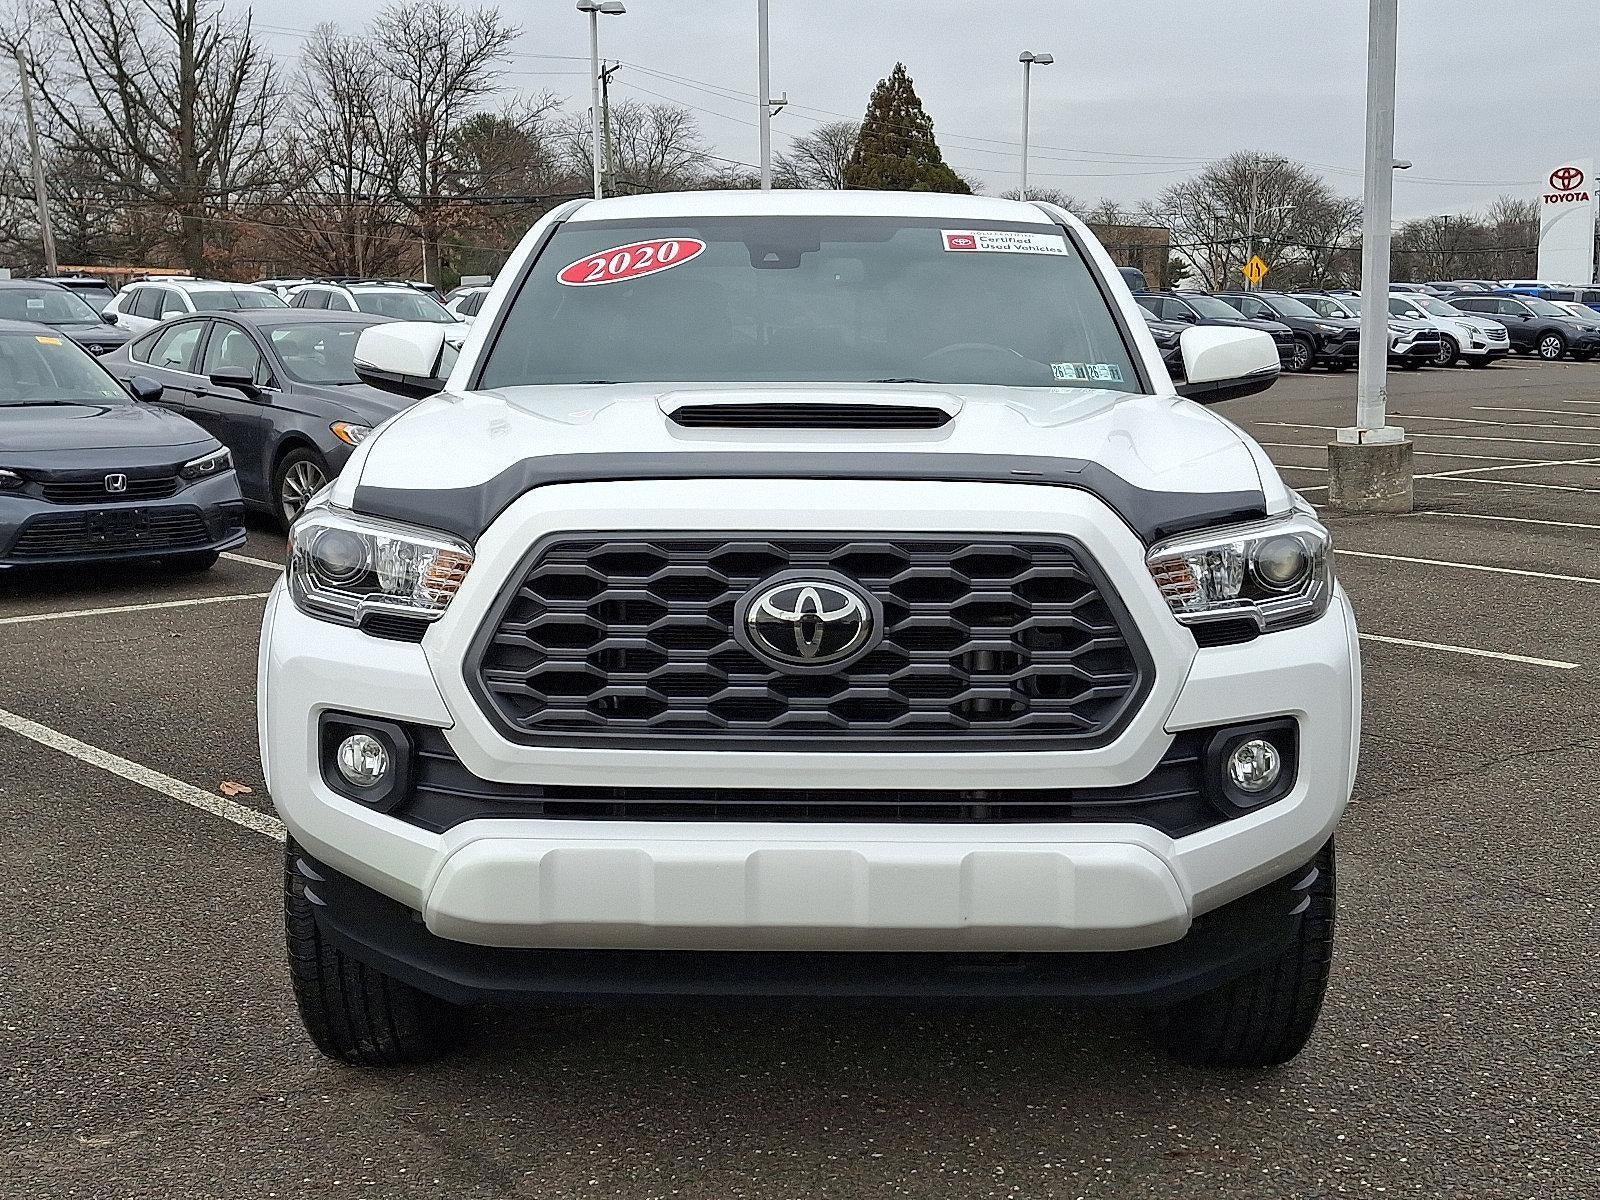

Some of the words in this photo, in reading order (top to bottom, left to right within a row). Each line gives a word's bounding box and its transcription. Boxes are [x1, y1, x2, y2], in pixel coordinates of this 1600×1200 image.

[1543, 192, 1589, 204] TOYOTA
[979, 236, 1031, 244] Certified
[1013, 244, 1063, 253] Vehicles
[583, 241, 680, 282] 2020
[1053, 365, 1064, 378] 26
[1088, 365, 1100, 379] 26
